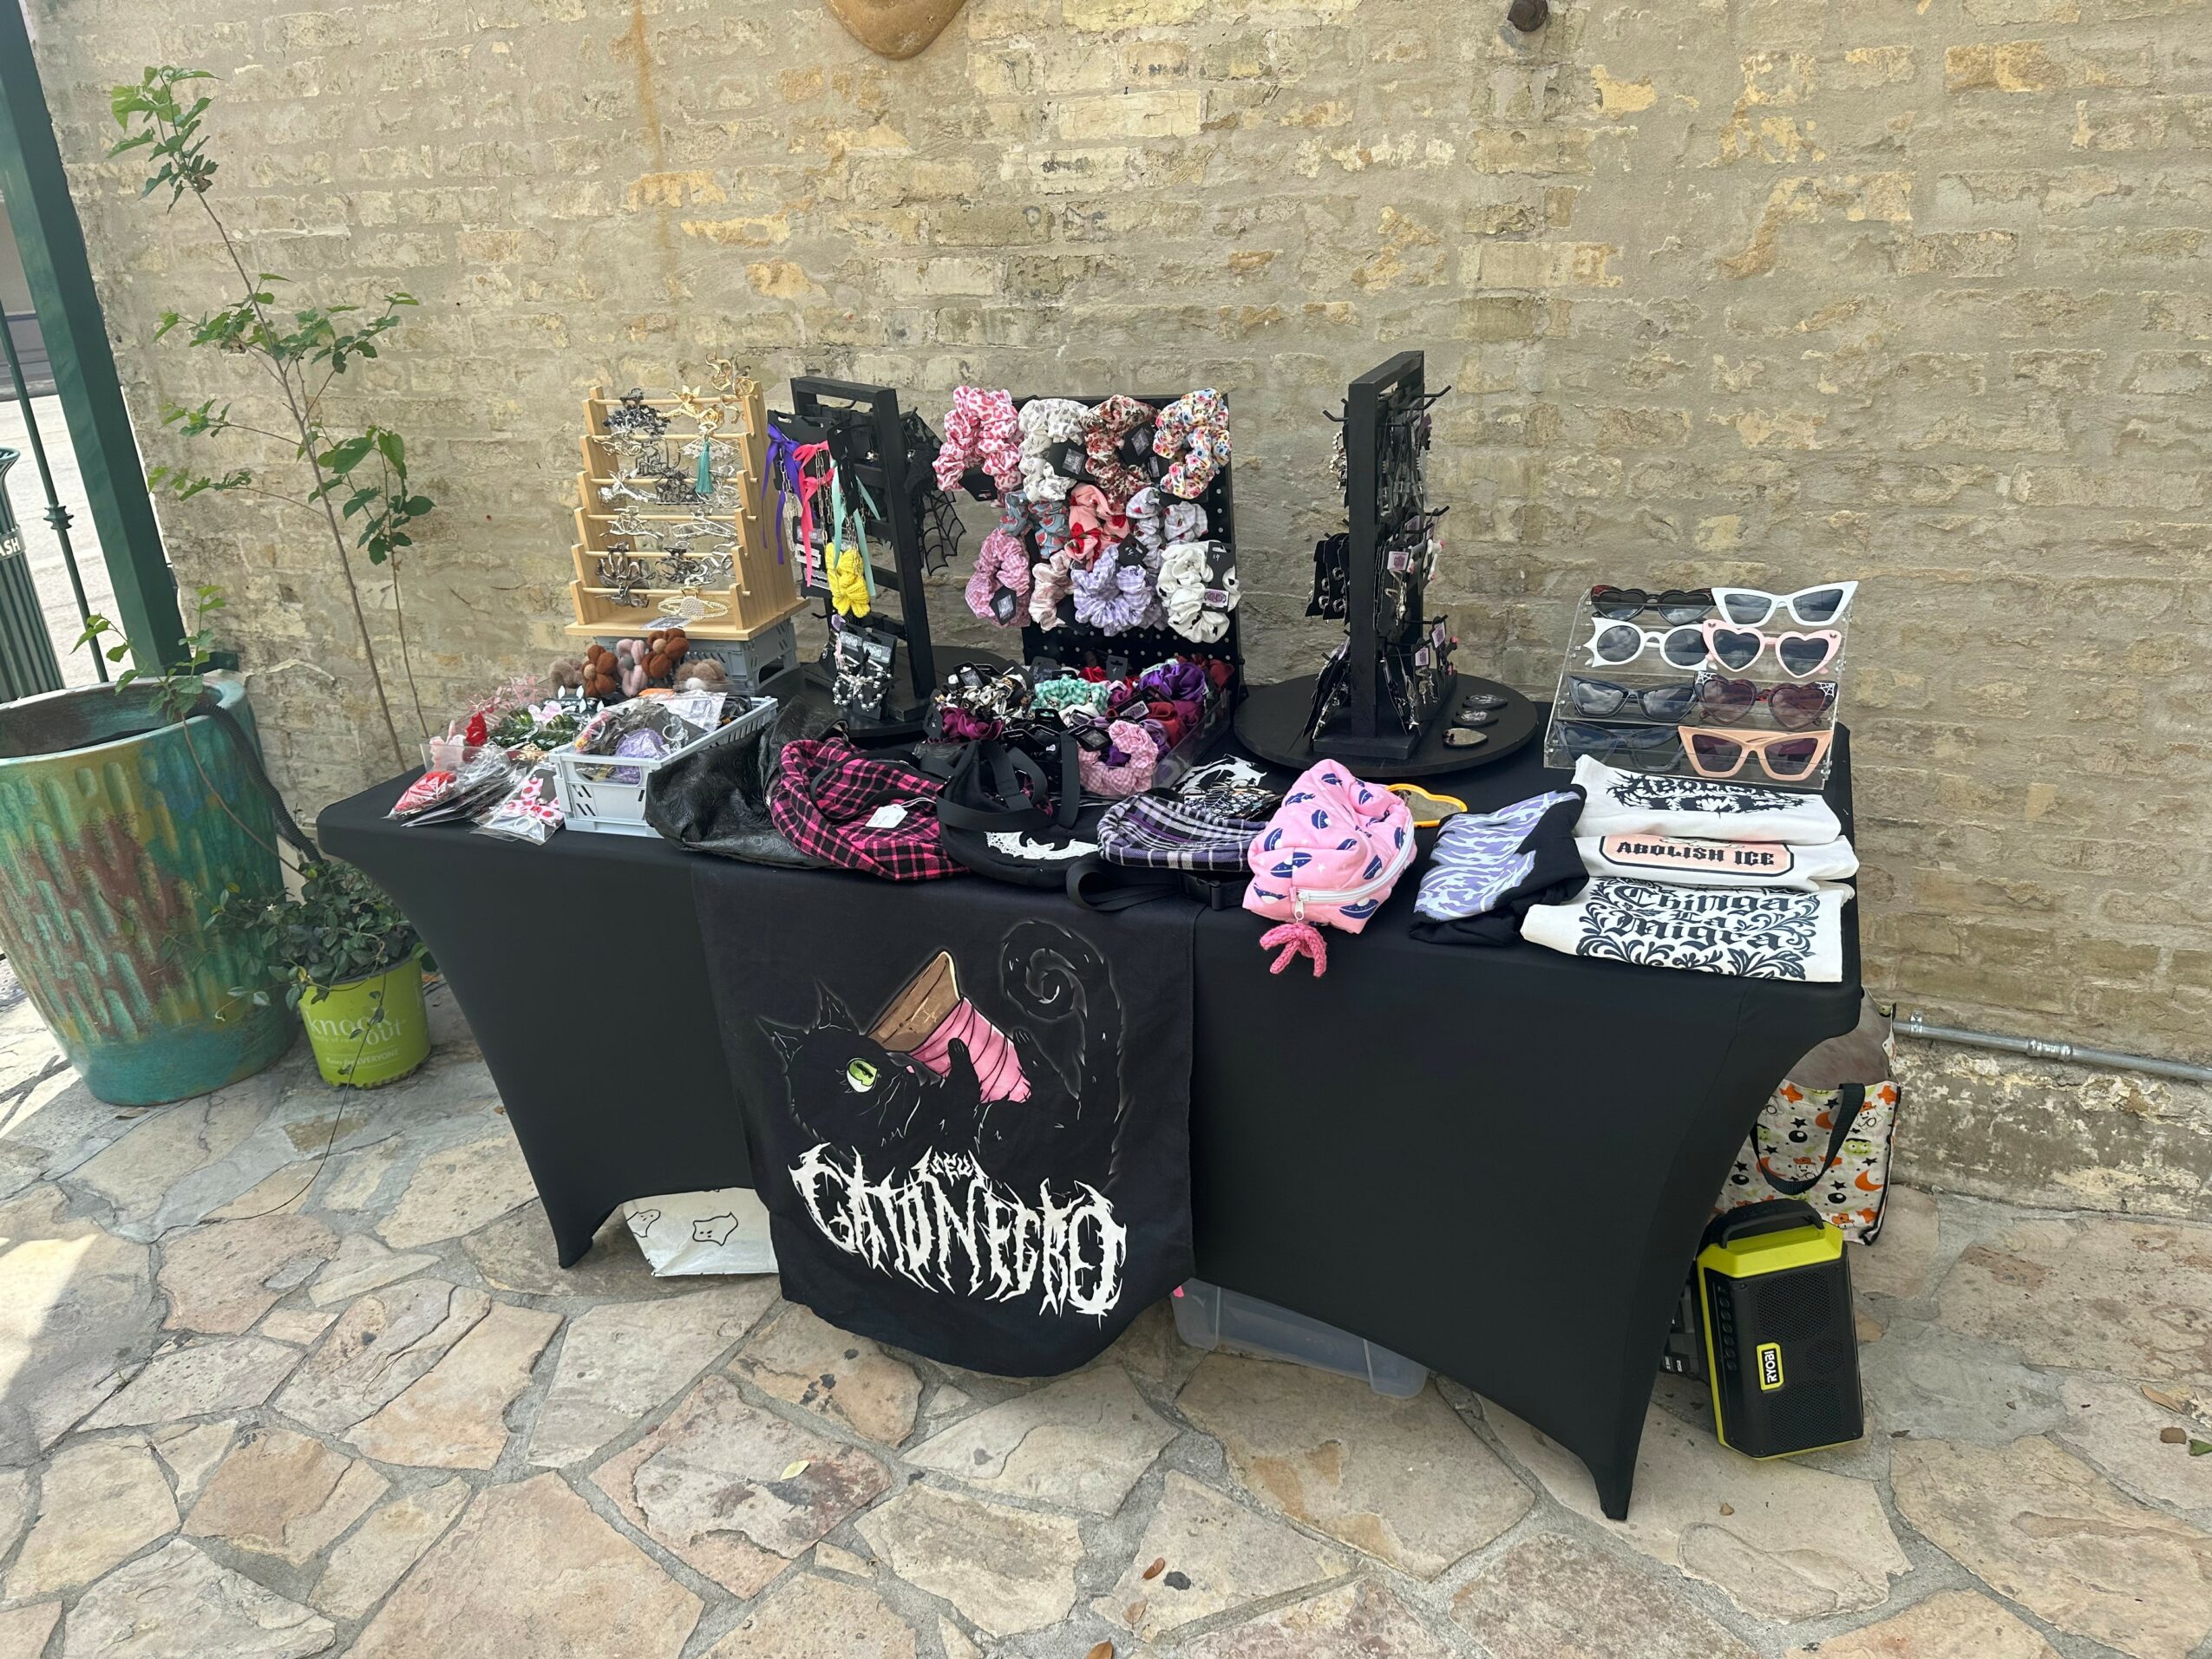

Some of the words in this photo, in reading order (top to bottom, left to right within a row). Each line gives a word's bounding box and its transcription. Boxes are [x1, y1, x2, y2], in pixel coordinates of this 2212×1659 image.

[1617, 842, 1725, 862] ABOLISH
[1734, 850, 1775, 866] ICE
[1613, 885, 1791, 911] Chinga
[1604, 911, 1781, 952] Migra
[1764, 1349, 1778, 1384] RYOBI
